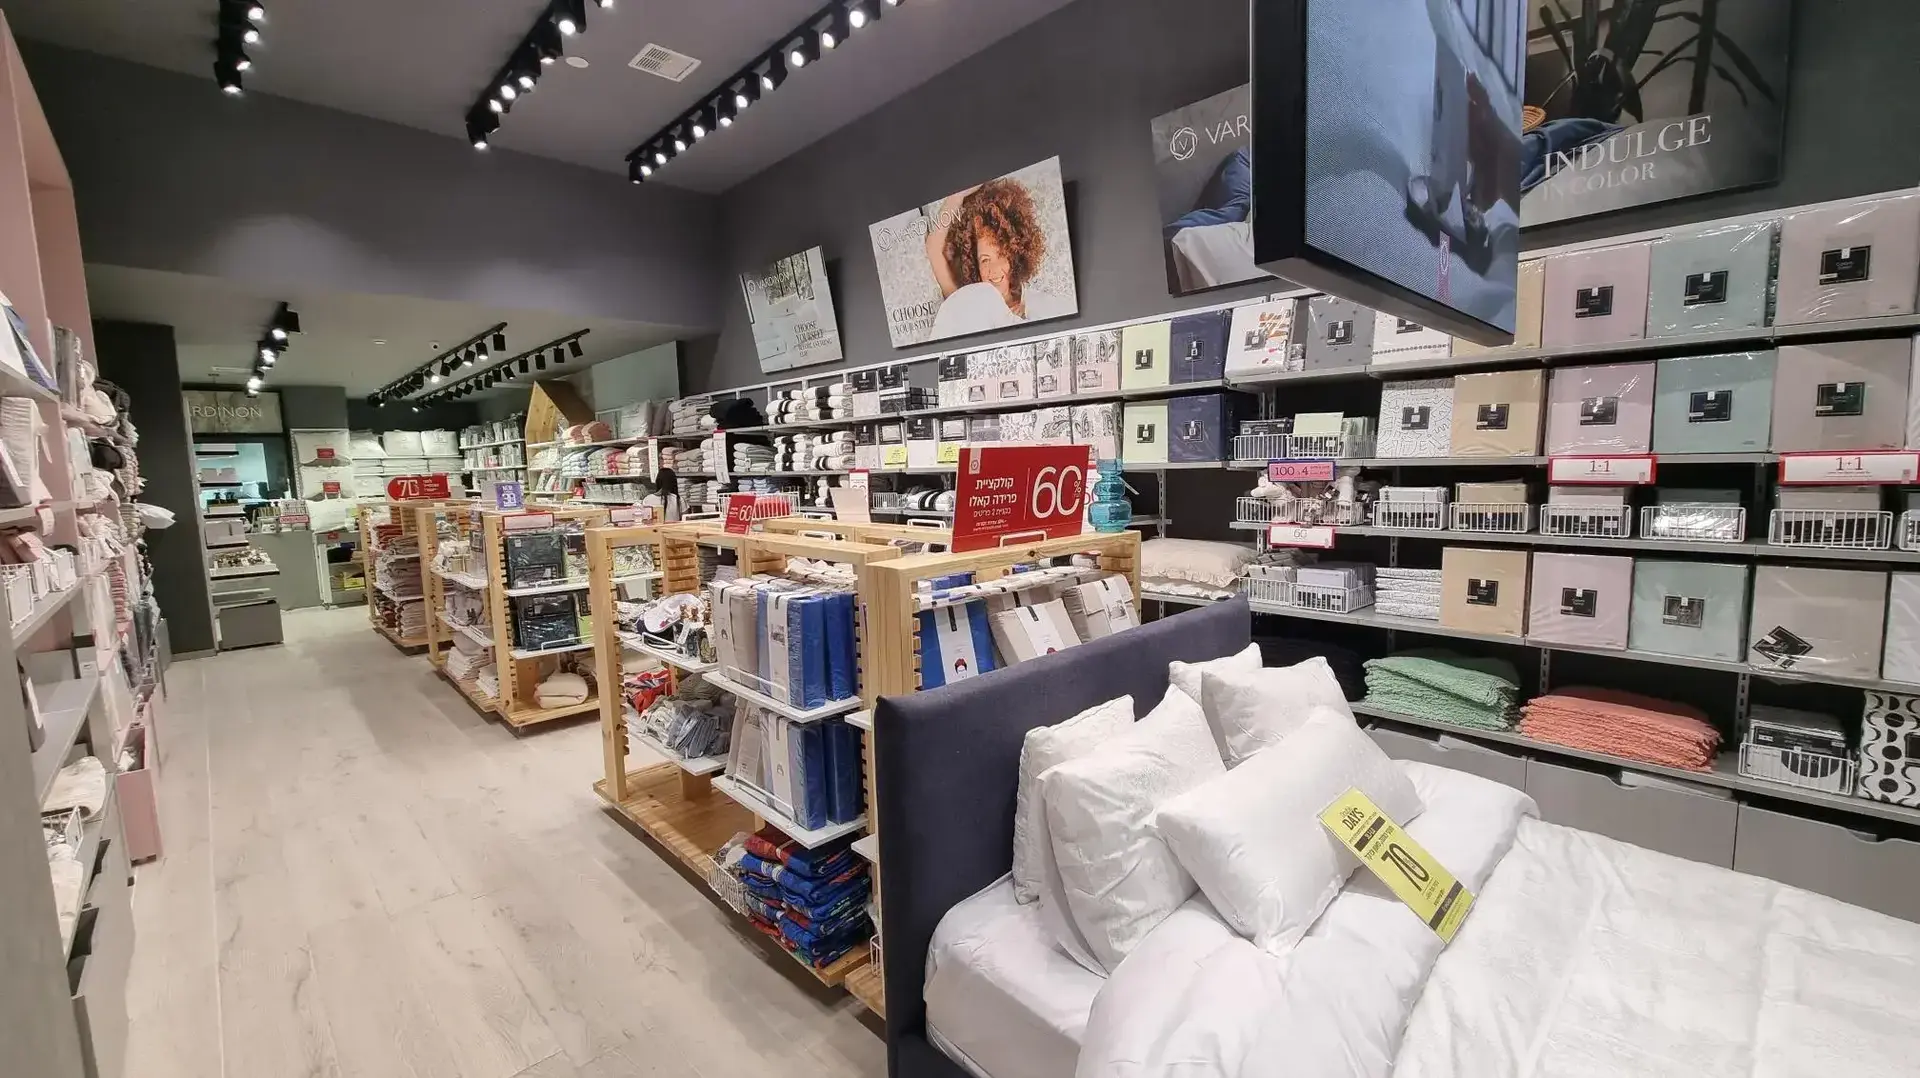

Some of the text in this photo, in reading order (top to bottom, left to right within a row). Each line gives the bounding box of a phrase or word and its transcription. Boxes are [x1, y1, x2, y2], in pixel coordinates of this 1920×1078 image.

[1543, 115, 1712, 178] INDULGE
[1570, 161, 1657, 196] COLOR
[892, 300, 936, 323] CHOOSE
[190, 405, 262, 418] RDINON
[1275, 466, 1295, 476] 100
[975, 477, 1014, 490] קולקציית
[968, 493, 1017, 507] פרידה קאלו
[1342, 807, 1365, 831] DAYS
[1380, 842, 1430, 892] 70
